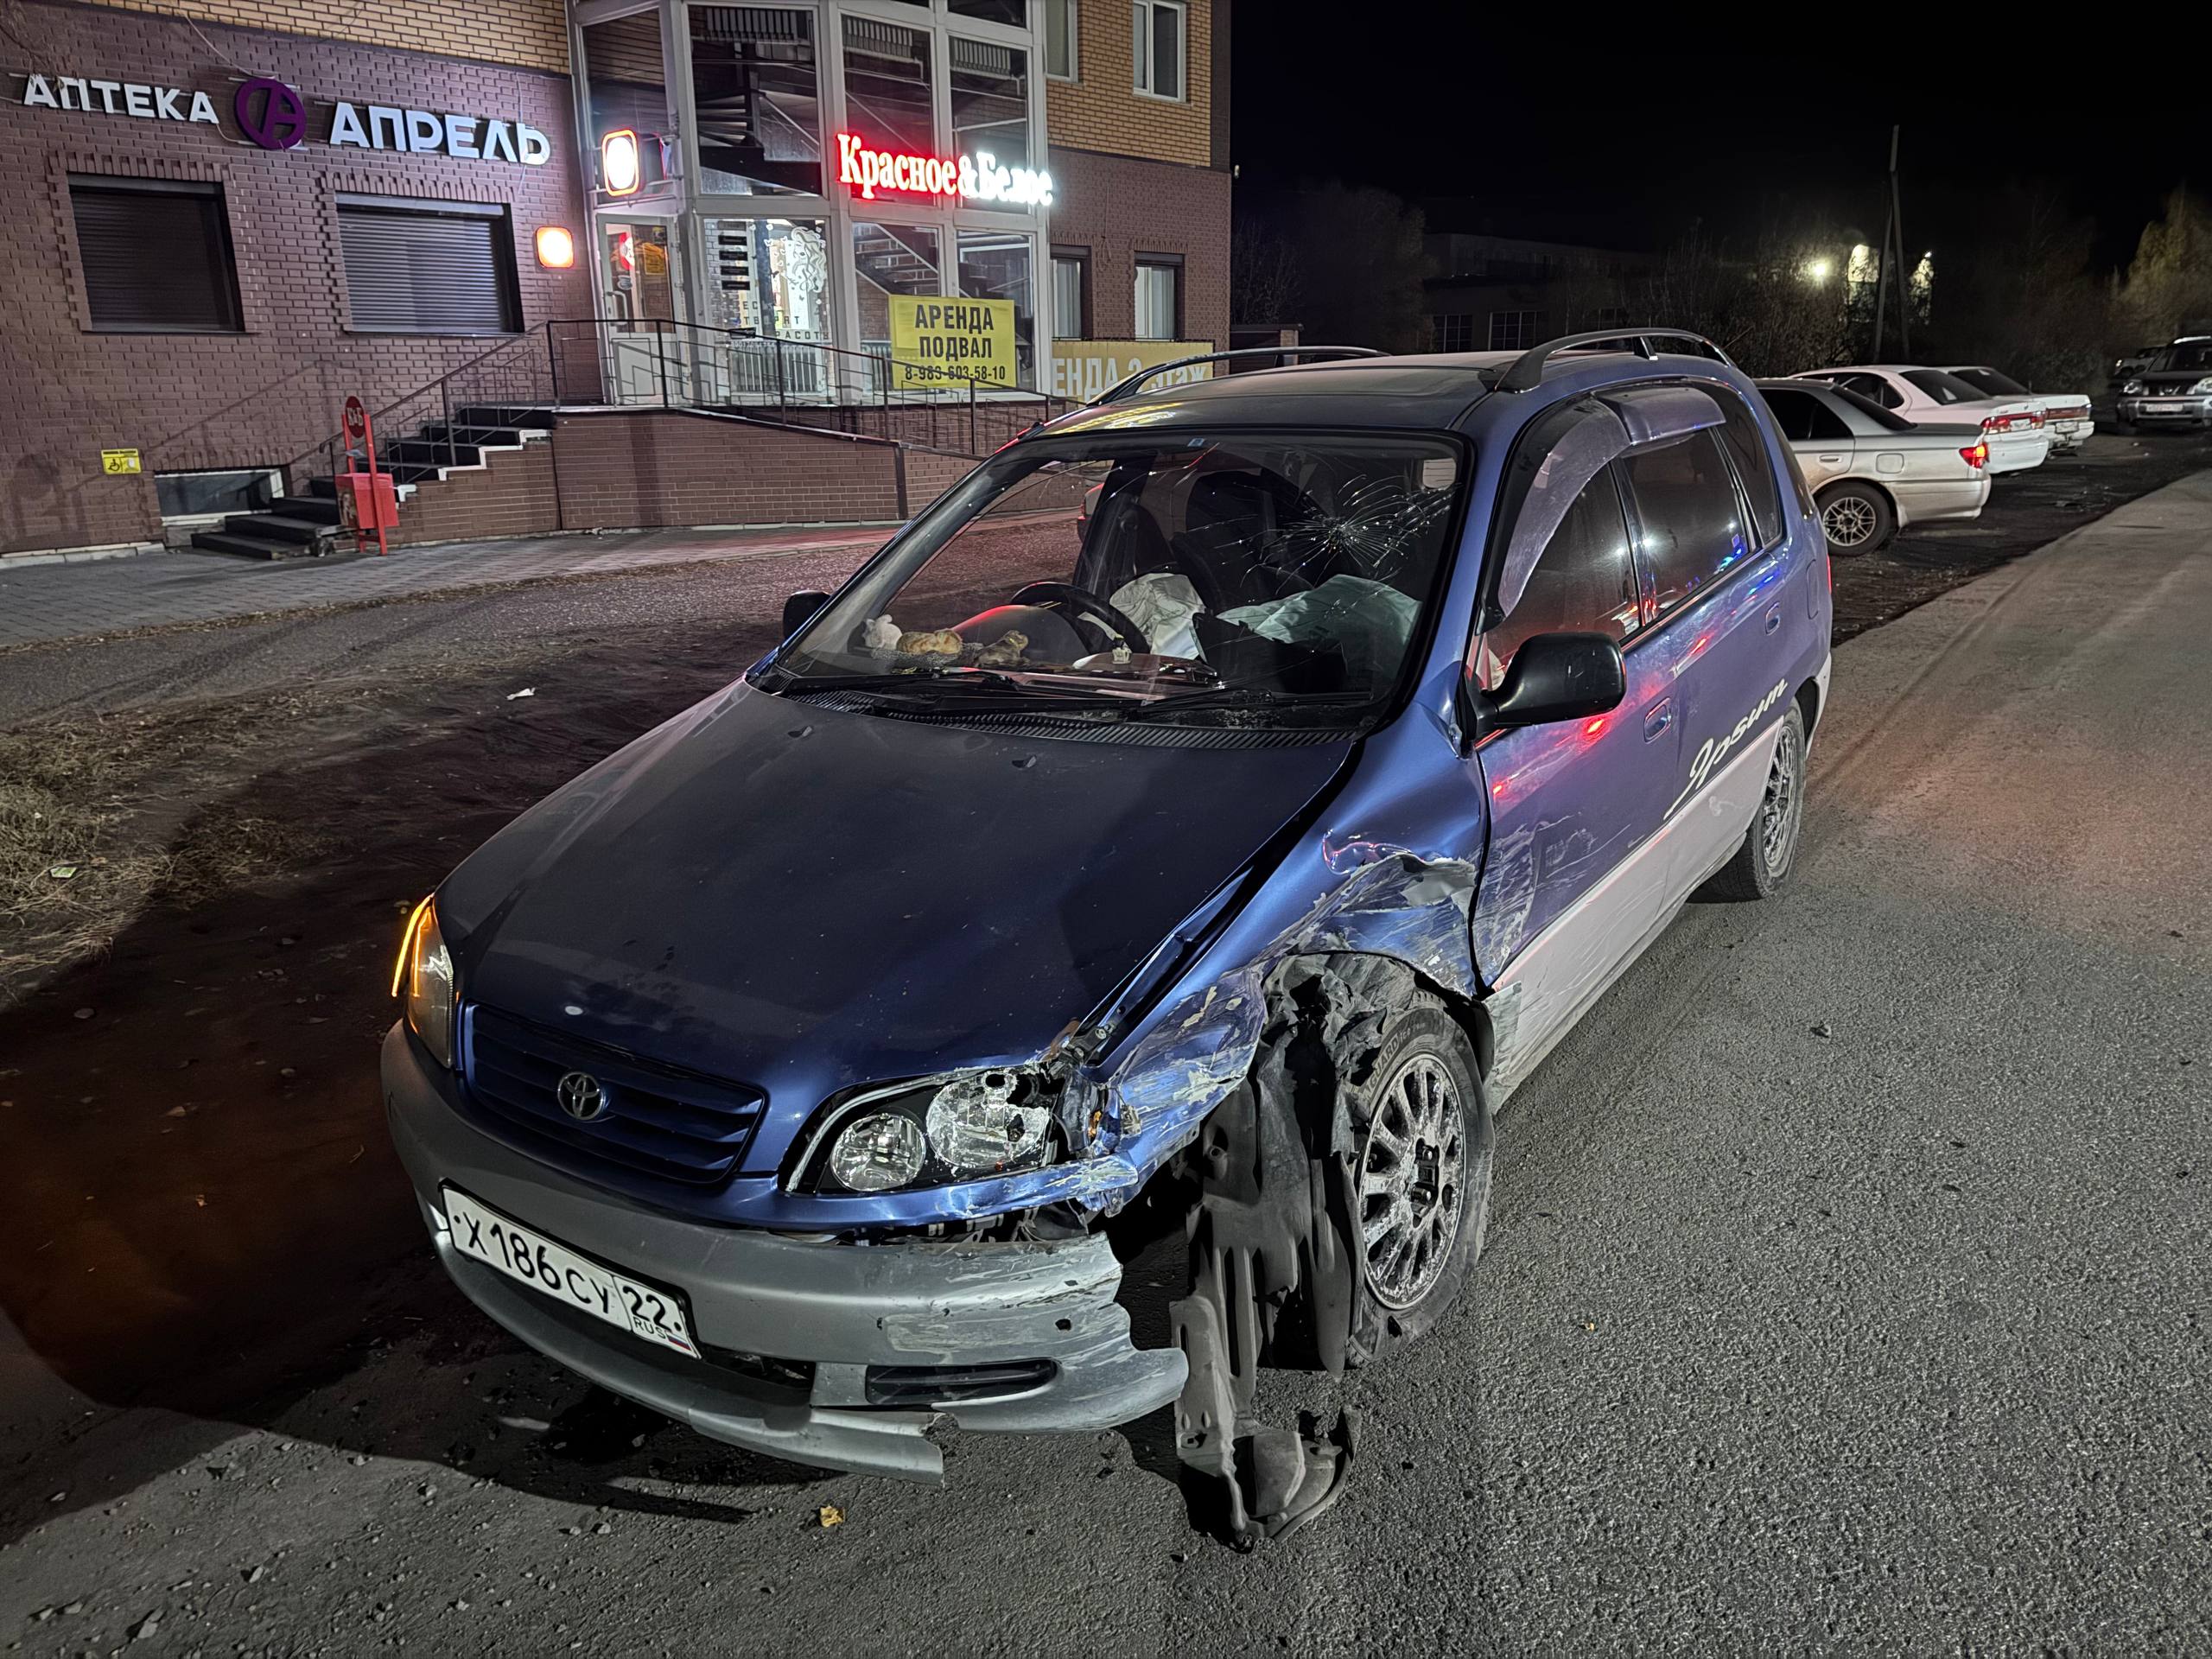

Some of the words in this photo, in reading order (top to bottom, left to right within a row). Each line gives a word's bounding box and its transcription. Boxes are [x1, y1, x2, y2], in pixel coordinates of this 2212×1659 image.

[22, 73, 219, 124] АПТЕКА
[329, 102, 551, 165] АПРЕЛЬ
[915, 304, 994, 334] АРЕНДА
[919, 336, 992, 361] ПОДВАЛ
[1051, 358, 1118, 402] ЕНДА
[1663, 678, 1788, 820] Ipsum
[623, 1285, 672, 1333] 22
[632, 1316, 666, 1339] RUS
